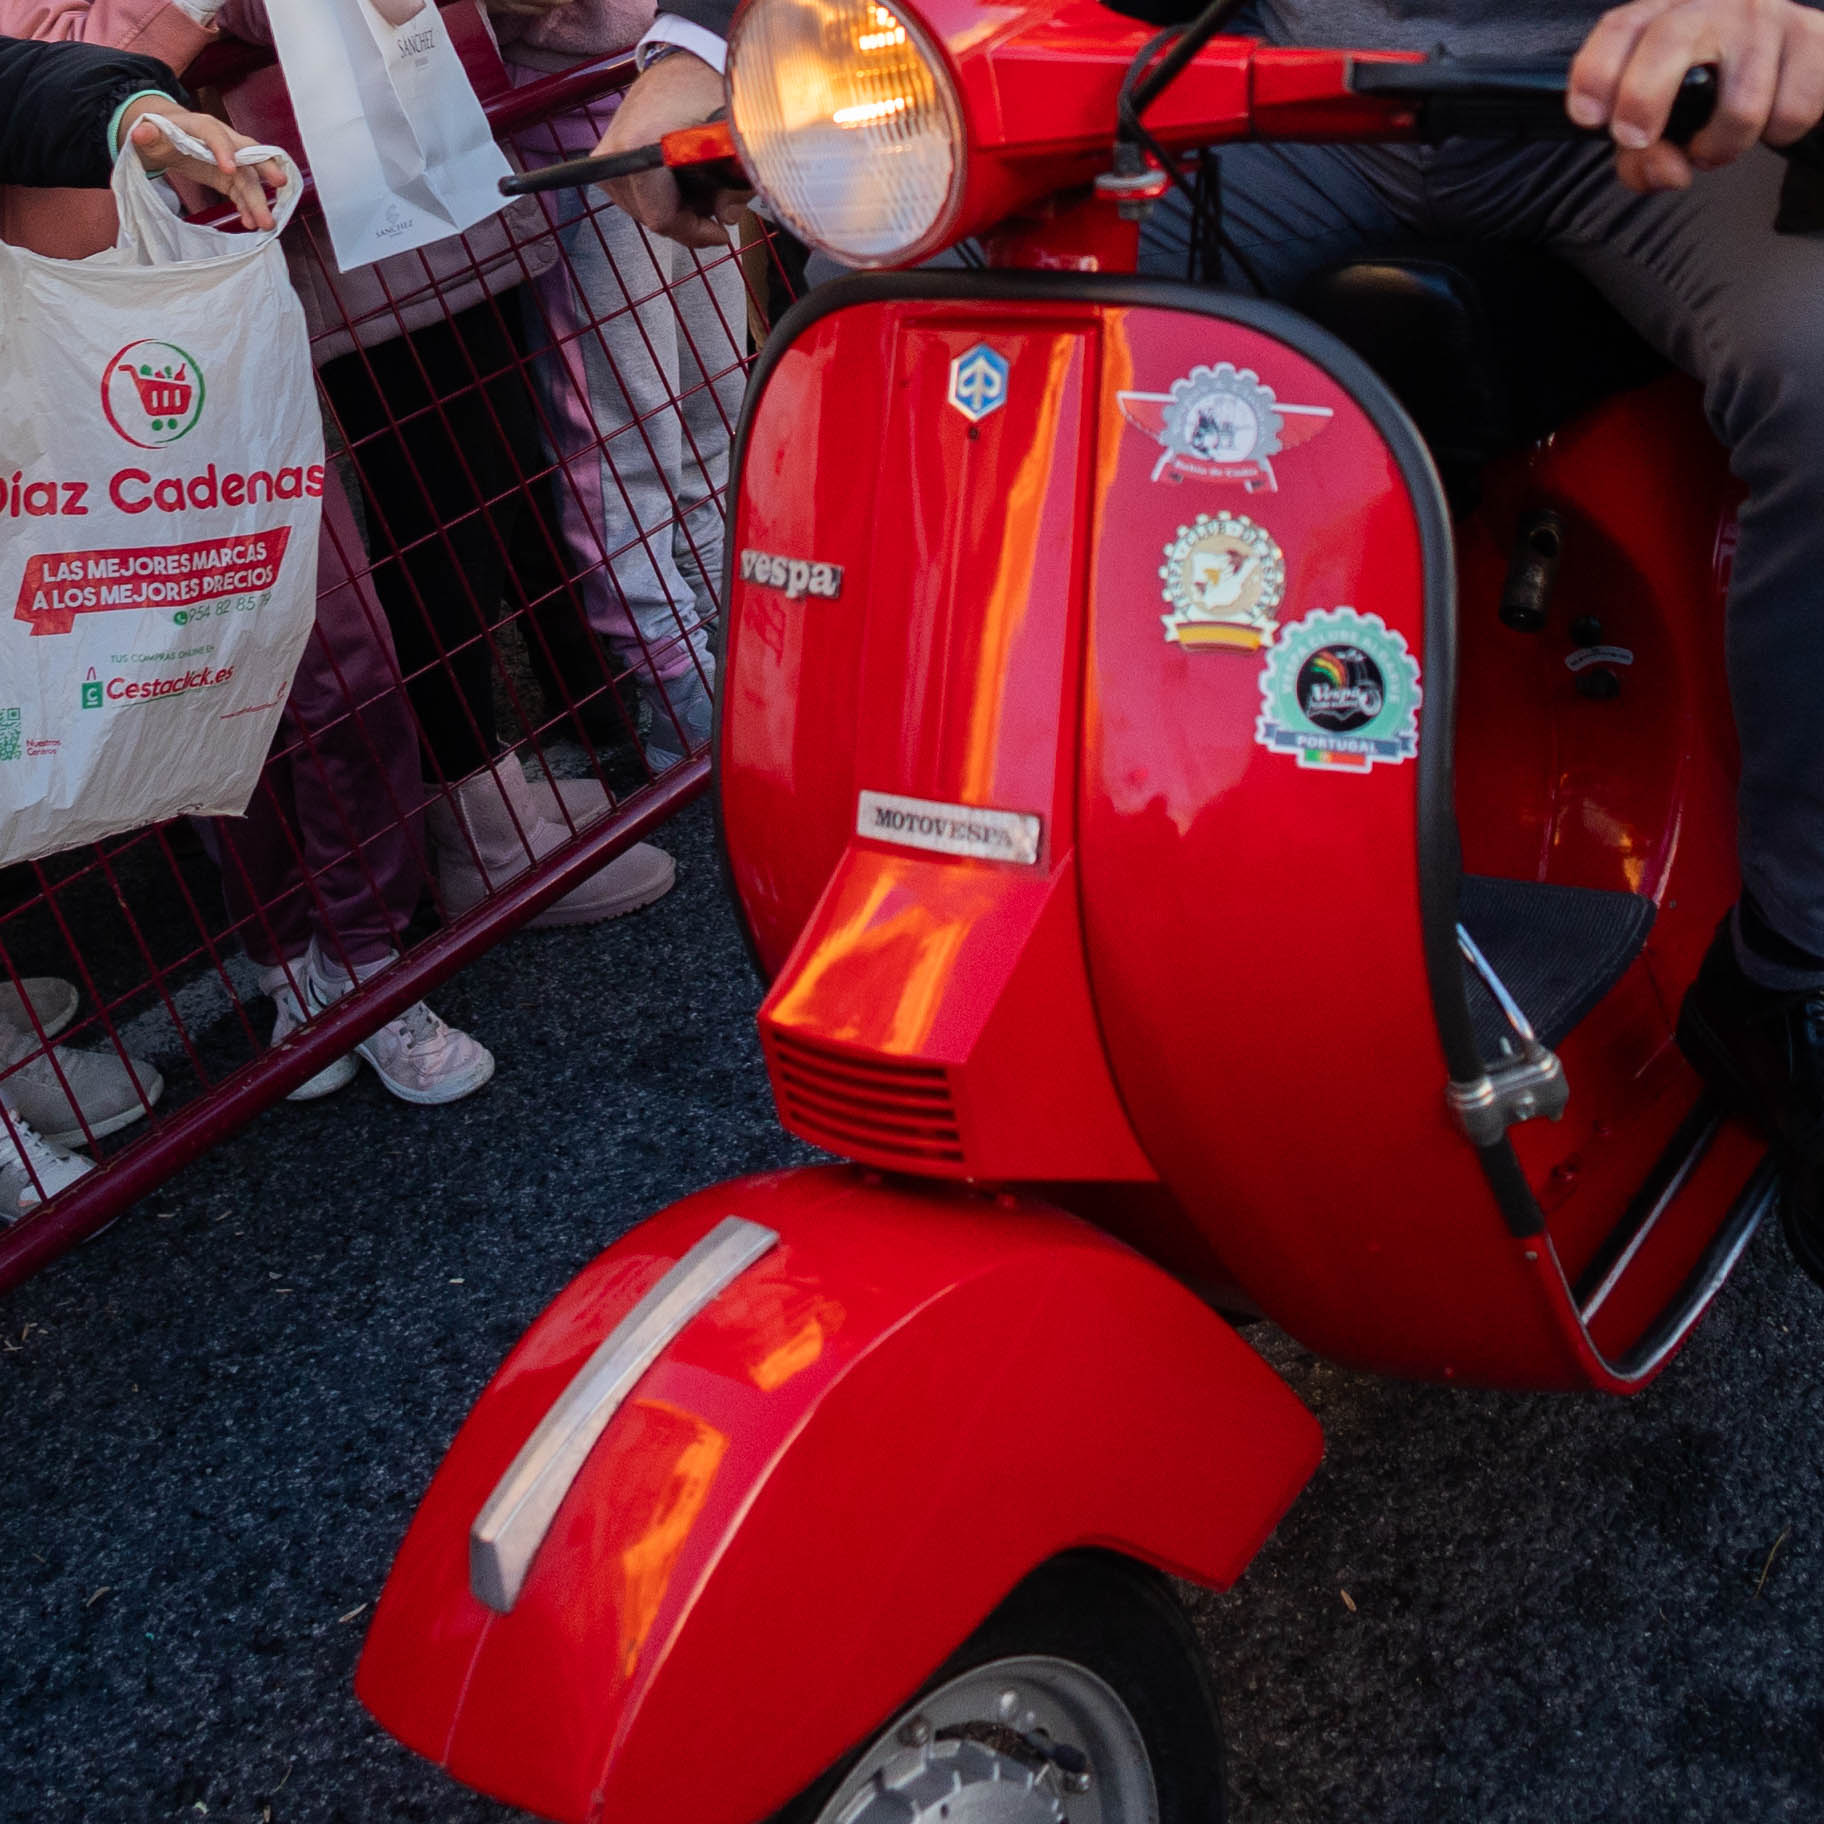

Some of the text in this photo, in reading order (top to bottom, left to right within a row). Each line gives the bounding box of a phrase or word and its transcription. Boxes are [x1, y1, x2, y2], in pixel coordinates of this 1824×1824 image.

[109, 462, 325, 515] Cadenas
[43, 541, 268, 583] LAS MEJORES MARCAS
[740, 548, 840, 599] vespa
[32, 565, 273, 611] A LOS MEJORES PRECIOS
[189, 605, 211, 623] 954
[215, 598, 231, 616] 82
[235, 596, 256, 612] 85
[106, 665, 236, 700] Cestaclick.es
[1296, 734, 1377, 753] PORTUGAL
[876, 806, 1014, 849] MOTOVESPA
